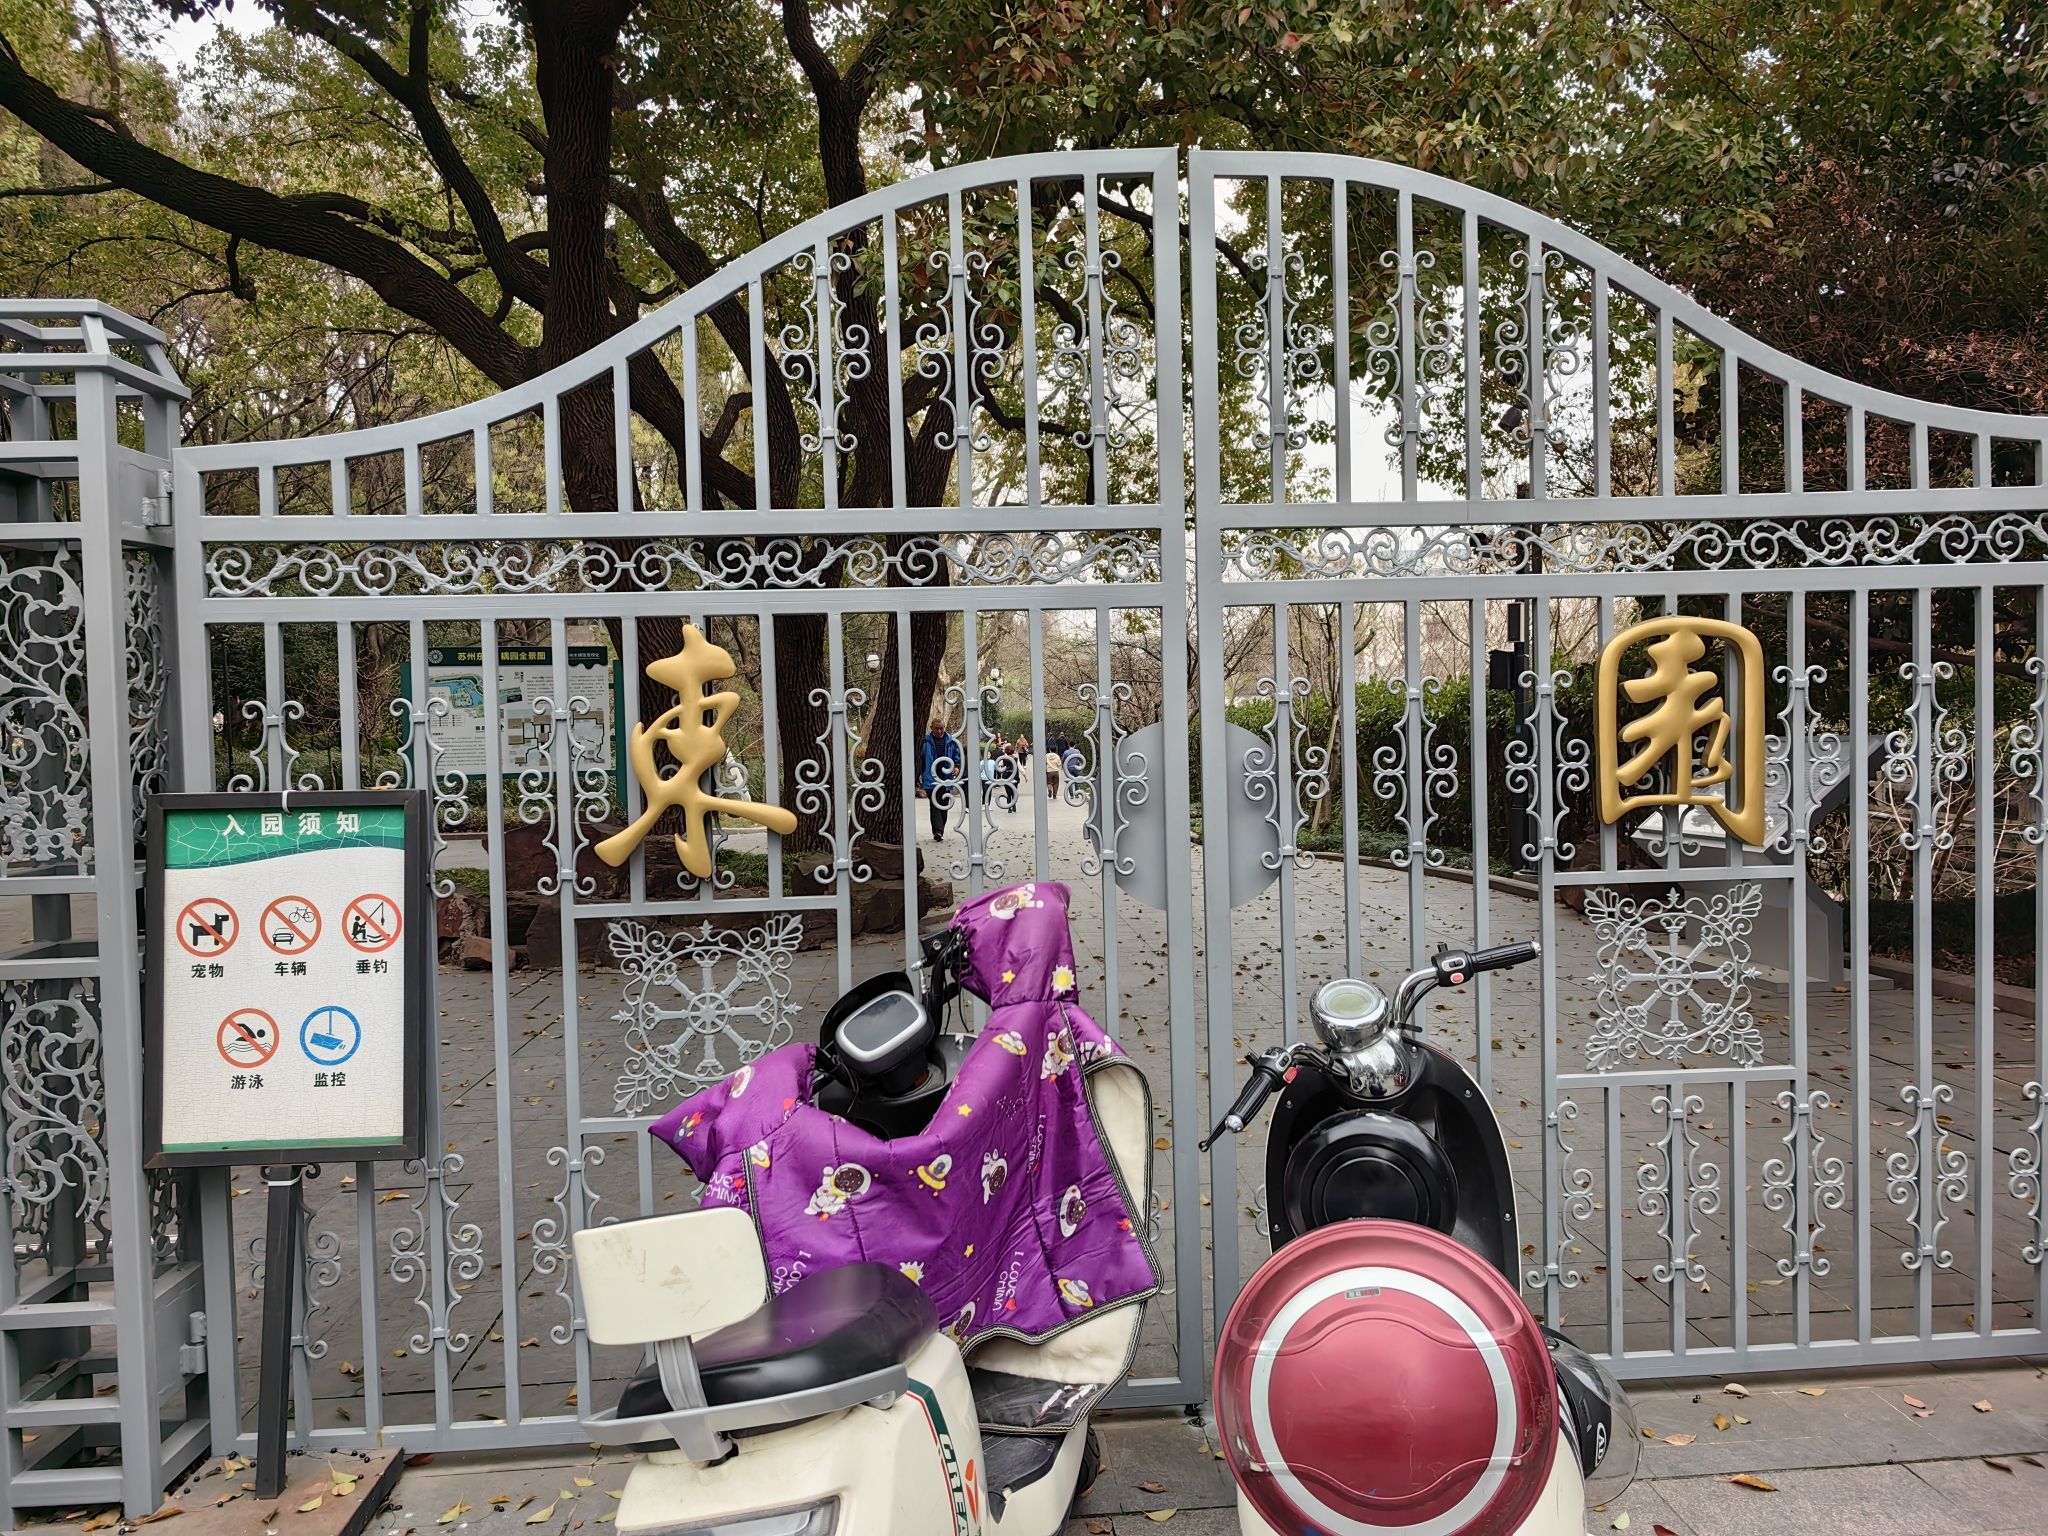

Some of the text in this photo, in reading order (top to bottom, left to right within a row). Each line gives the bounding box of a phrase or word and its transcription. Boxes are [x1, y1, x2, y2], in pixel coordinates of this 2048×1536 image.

[223, 811, 360, 836] 入园须知
[191, 959, 388, 978] 宠物 车辆 垂钓
[230, 1071, 346, 1090] 游泳 监控
[705, 1184, 742, 1208] CHINA
[798, 1250, 812, 1258] I
[992, 1270, 1008, 1312] CHINA
[1006, 1261, 1021, 1298] LOVE
